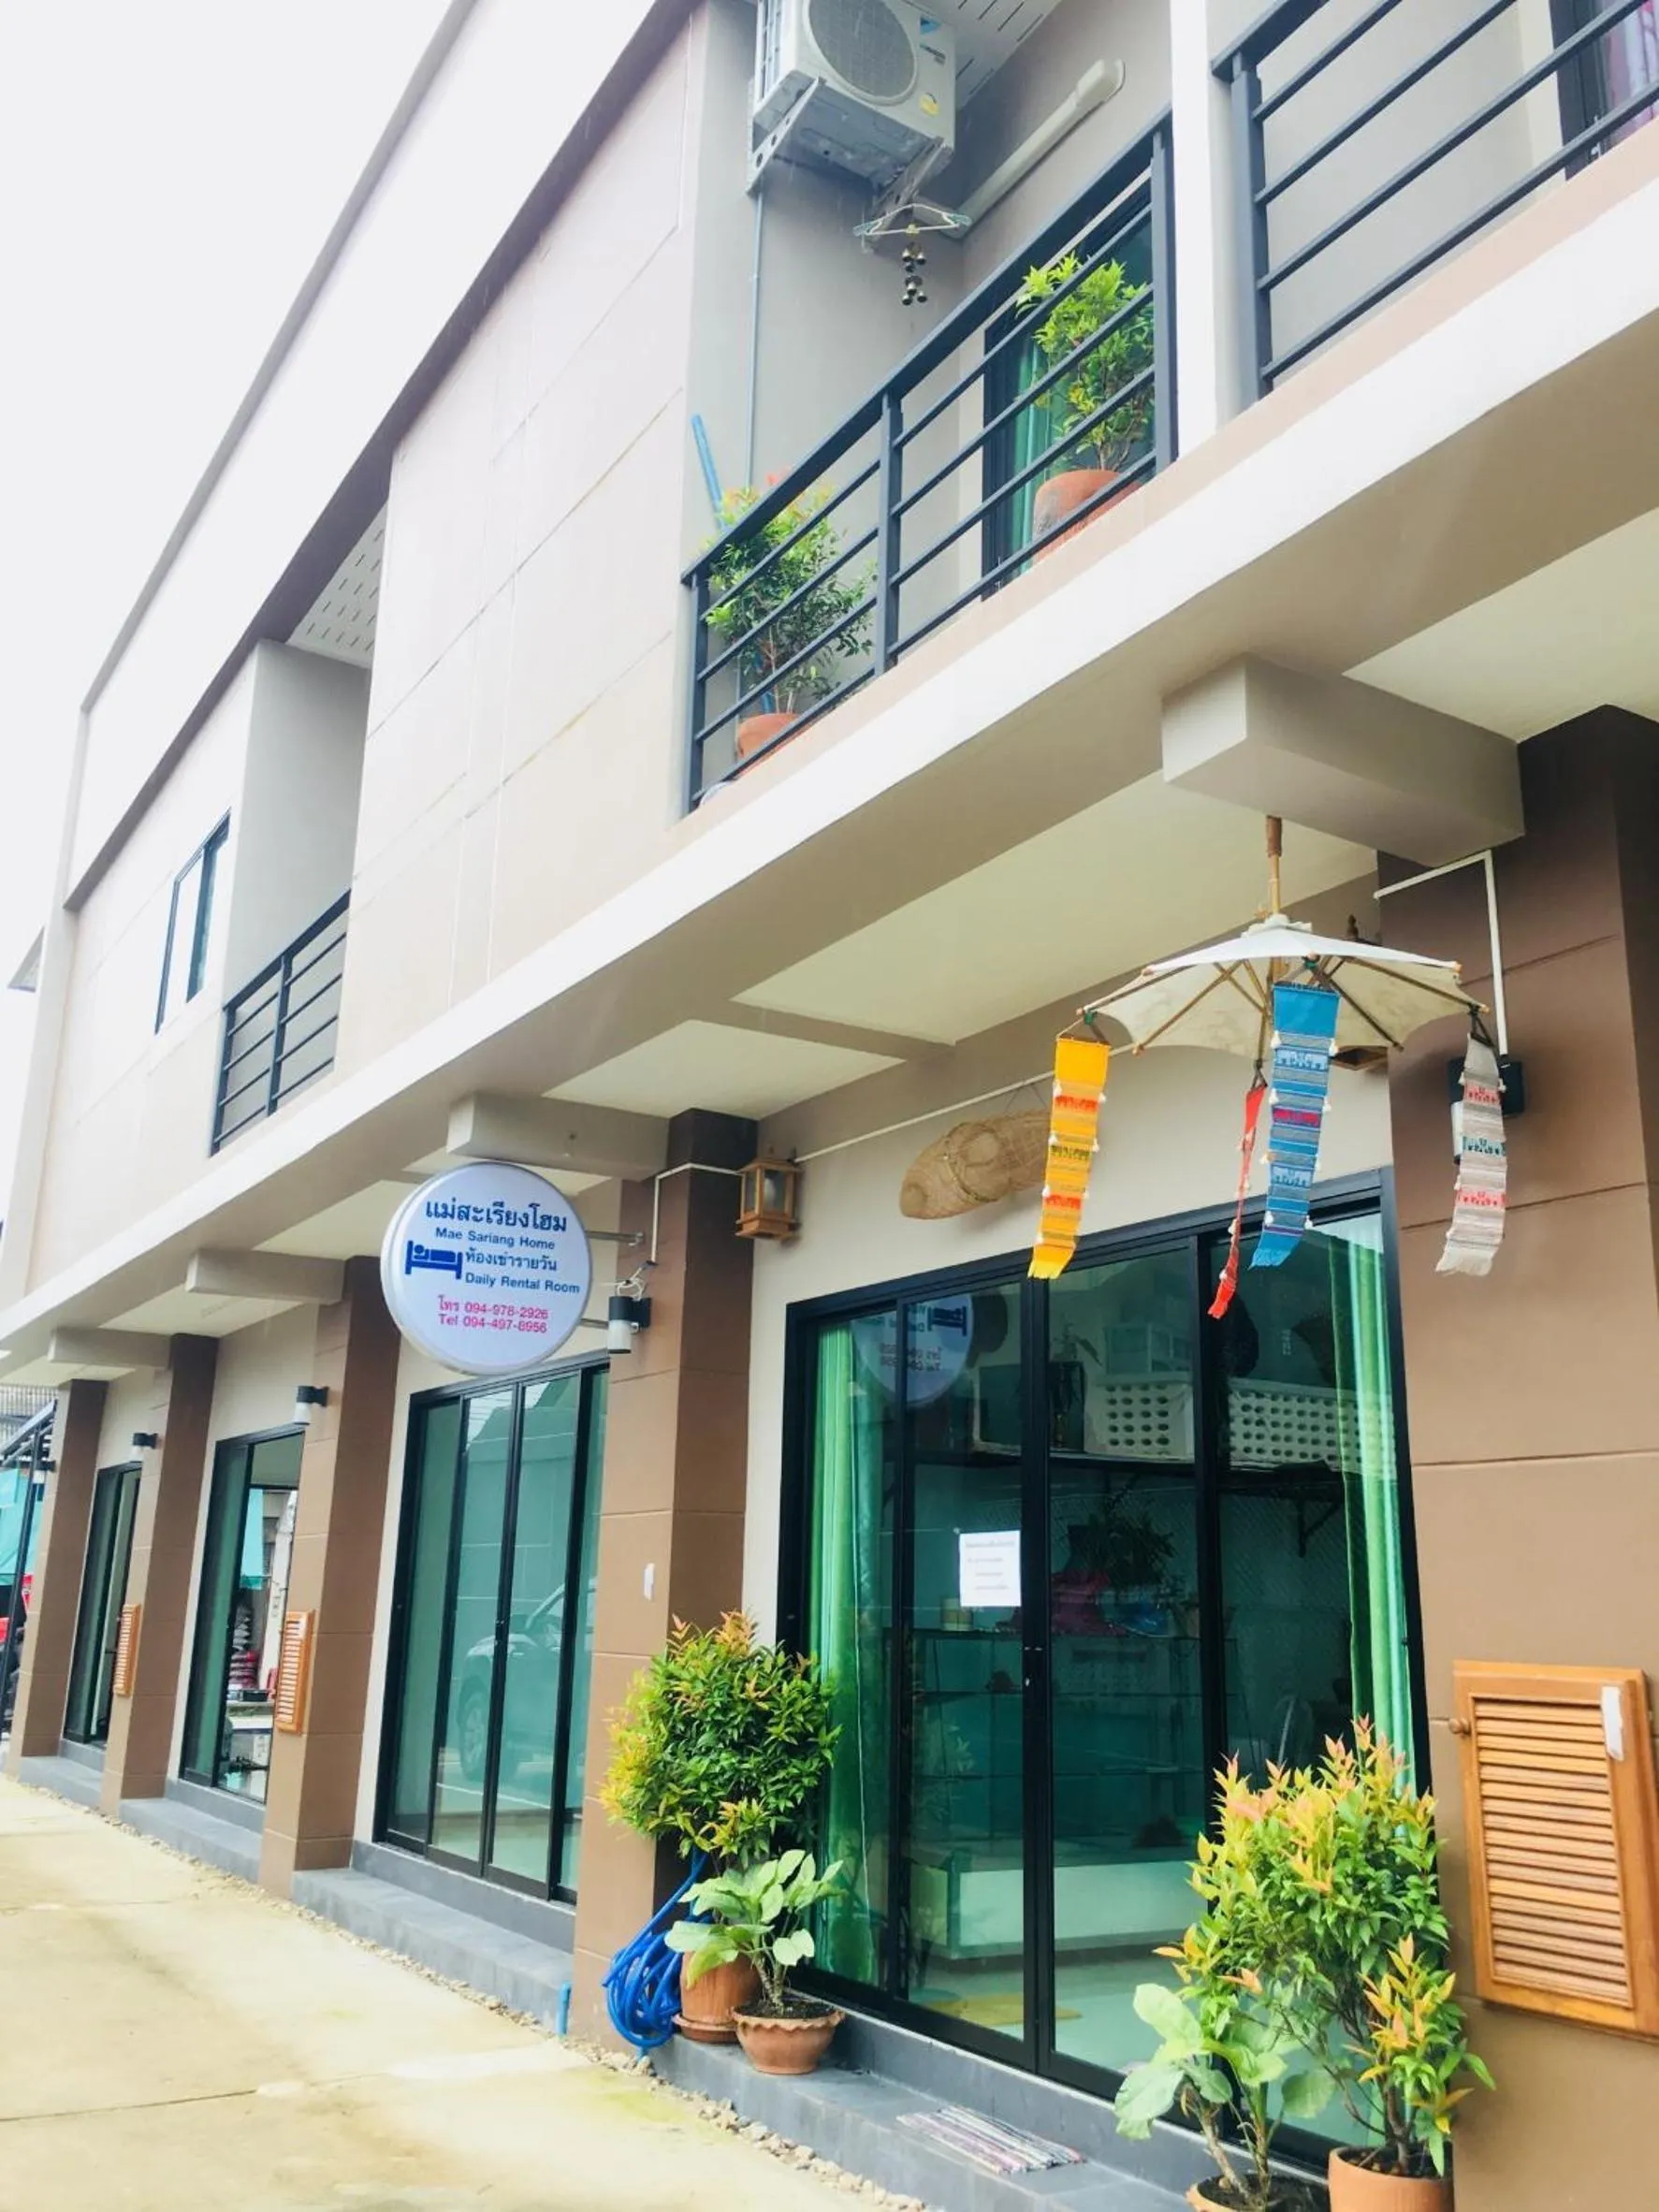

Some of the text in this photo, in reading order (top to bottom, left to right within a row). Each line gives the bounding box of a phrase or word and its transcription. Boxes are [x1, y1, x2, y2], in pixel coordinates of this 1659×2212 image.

[426, 1198, 567, 1232] แม่สะเรียงโฮม
[435, 1227, 556, 1249] Mae Sariang Home
[465, 1247, 557, 1272] ห้องเช่ารายวัน
[465, 1273, 580, 1293] Daily Rental Room
[438, 1295, 459, 1311] โทร
[439, 1314, 458, 1325] Tel
